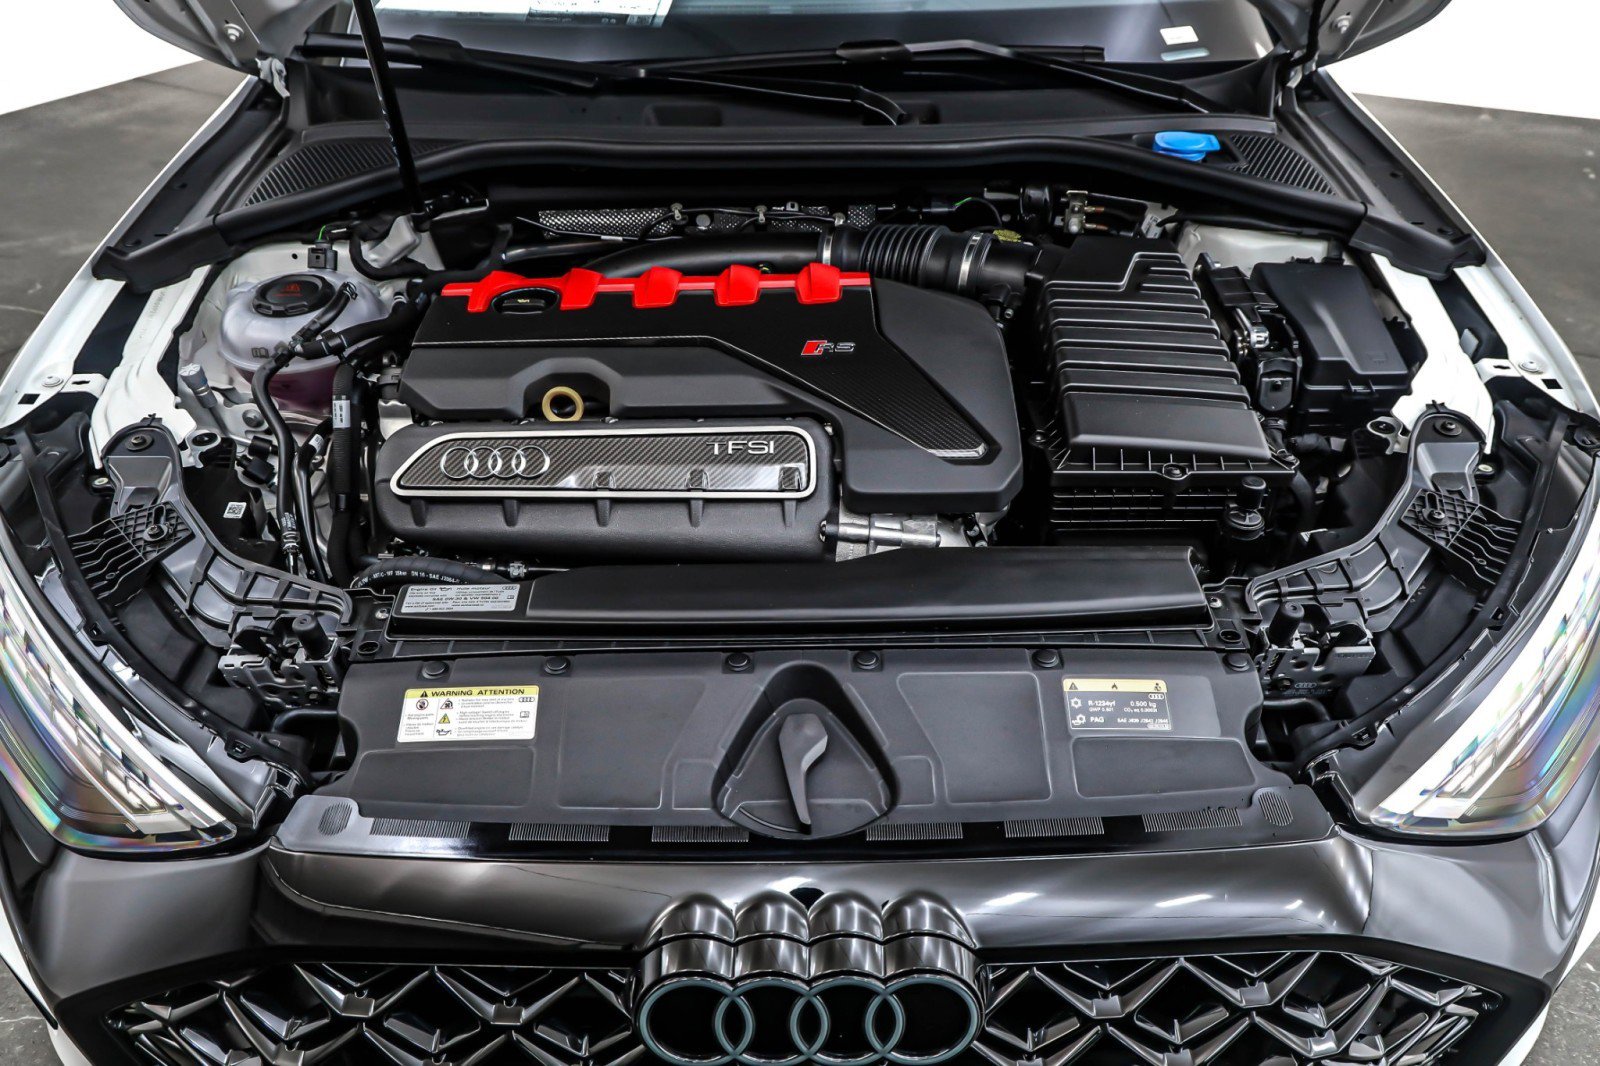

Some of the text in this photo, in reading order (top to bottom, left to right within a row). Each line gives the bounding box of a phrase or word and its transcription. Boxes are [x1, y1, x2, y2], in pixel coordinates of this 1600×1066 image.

[801, 340, 856, 355] RS
[706, 440, 775, 455] TFSI
[477, 688, 525, 696] ATTENTION
